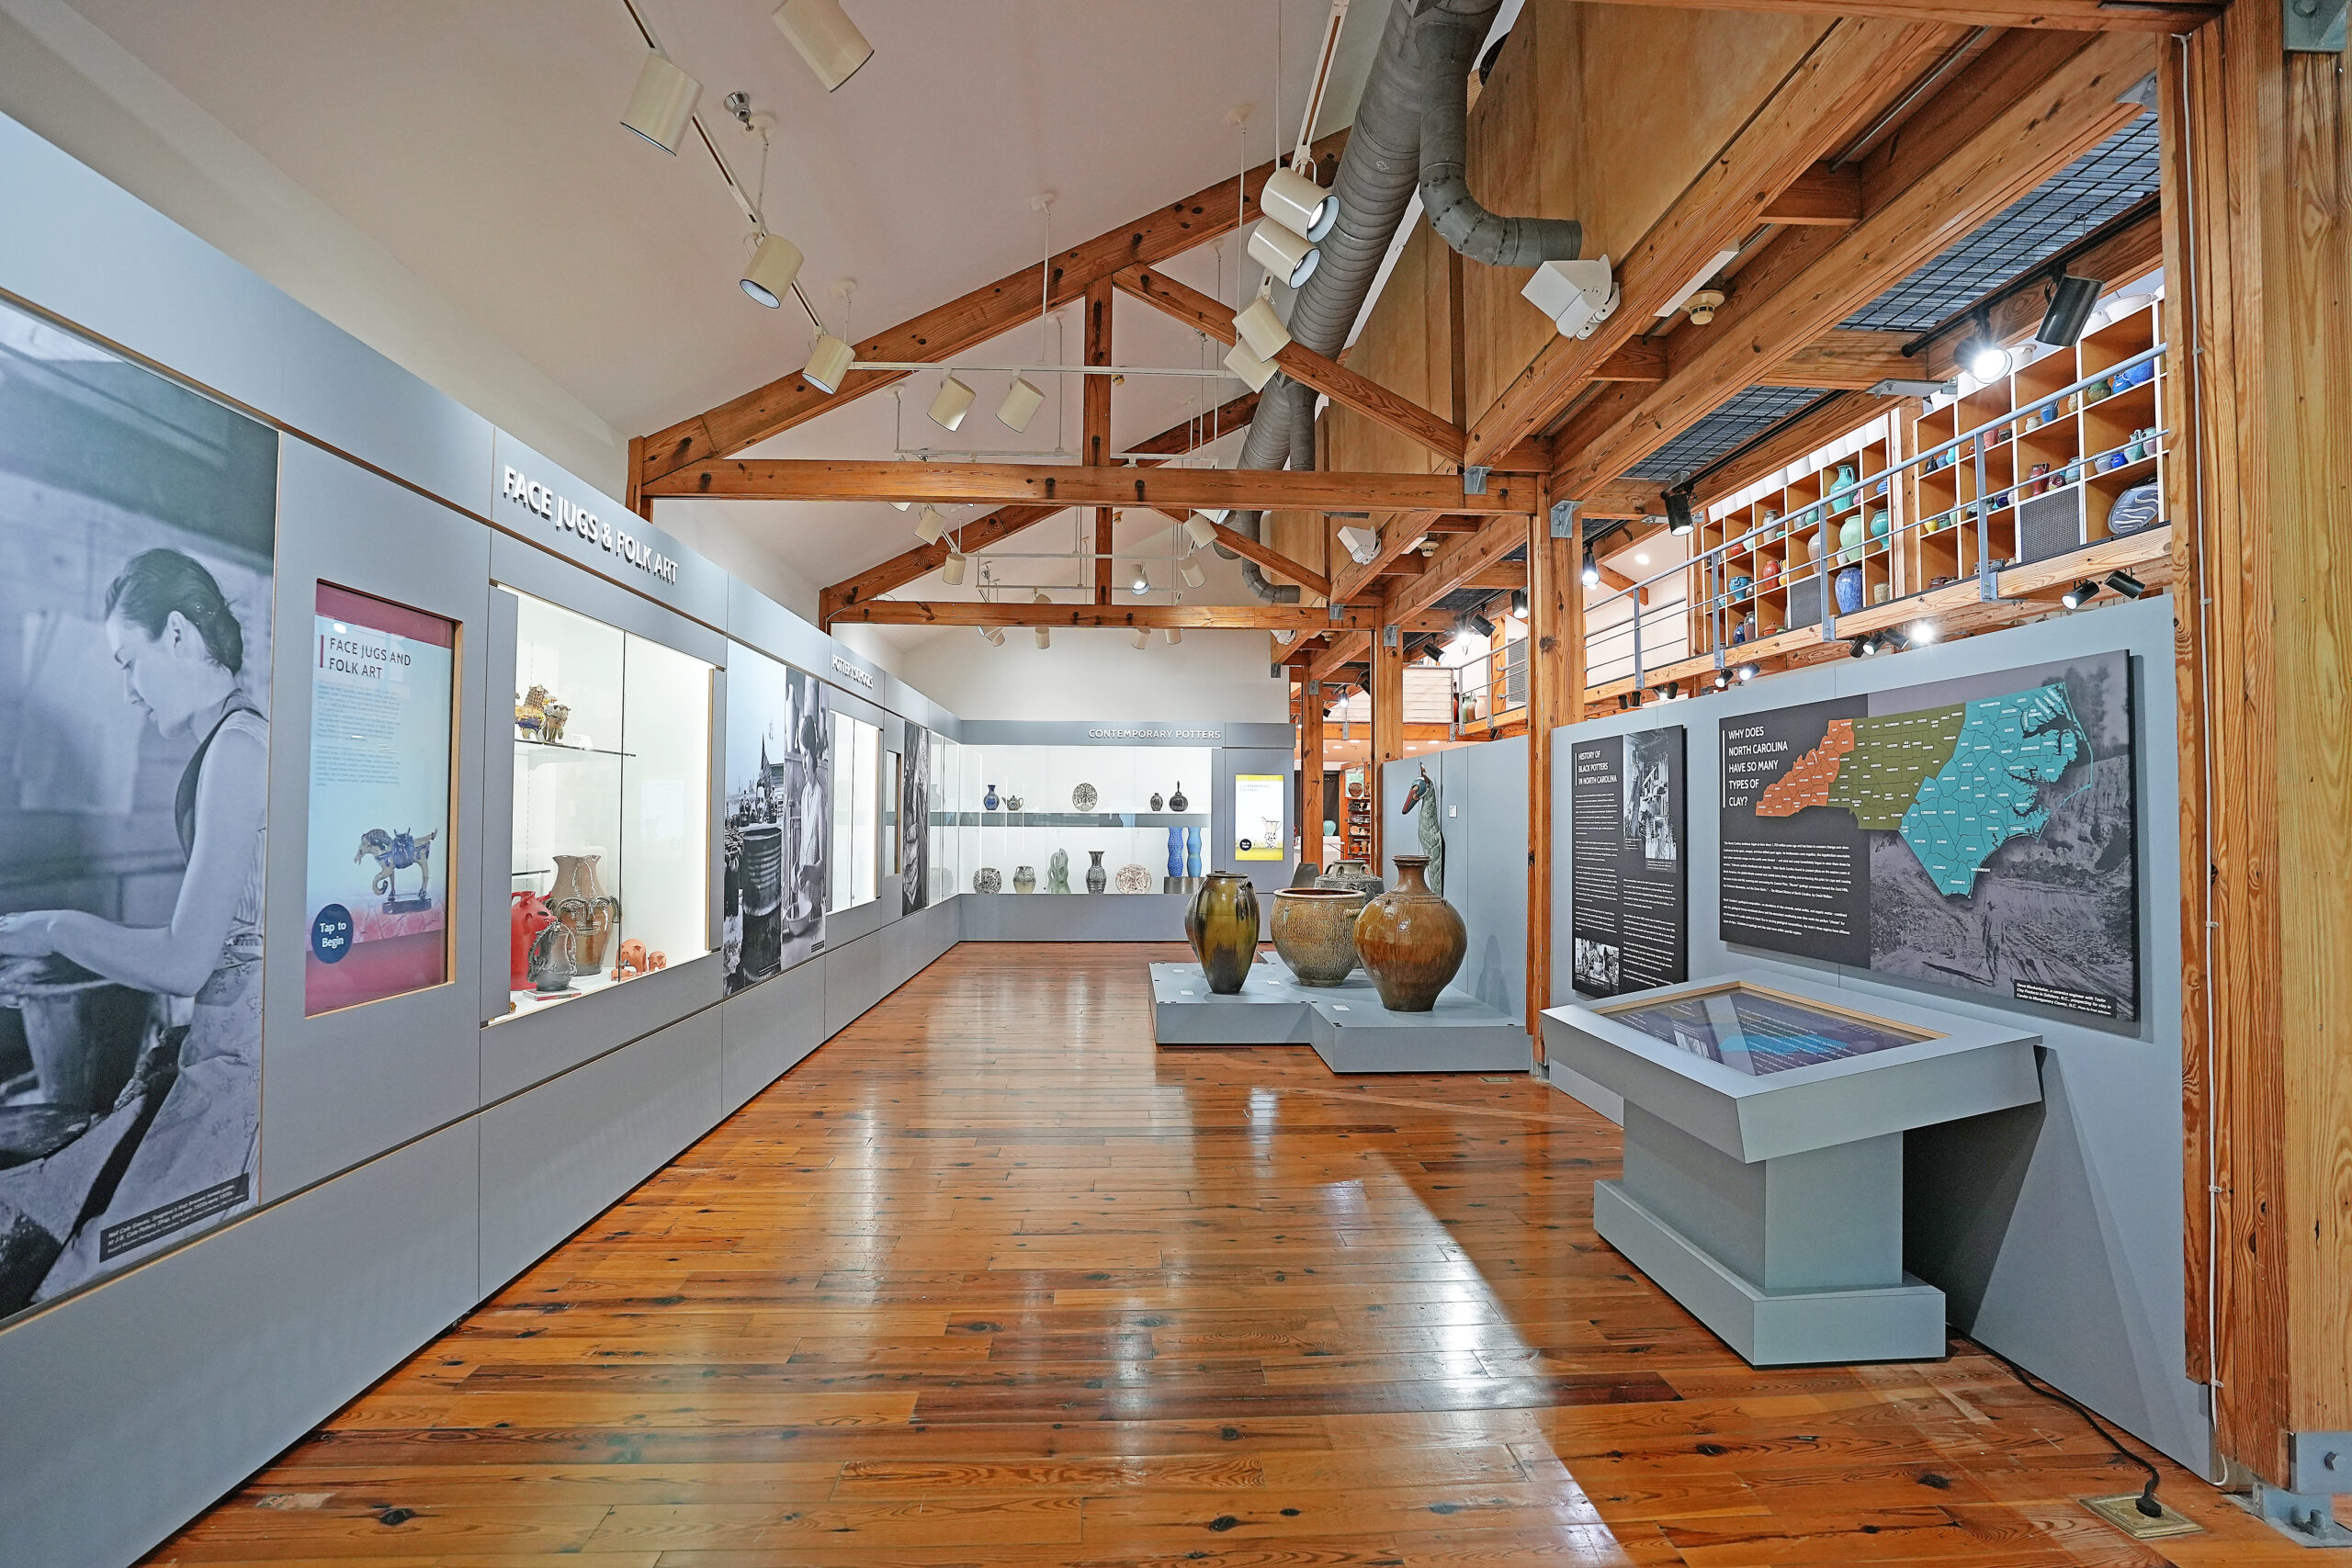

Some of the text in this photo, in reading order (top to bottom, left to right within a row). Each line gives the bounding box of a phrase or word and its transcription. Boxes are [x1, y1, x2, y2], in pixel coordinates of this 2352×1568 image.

[503, 465, 678, 582] FACE JUGS & FOLK ART
[330, 637, 411, 666] FACE JUGS AND
[329, 657, 382, 679] FOLK ART
[1089, 728, 1221, 739] CONTEMPORARY POTTERS
[1728, 726, 1764, 740] WHY DOES
[1728, 740, 1788, 757] NORTH CAROLINA
[1577, 750, 1601, 761] HISTORY OF
[1577, 762, 1609, 773] BLACK POTTERS
[1728, 760, 1779, 773] HAVE SO MANY
[1577, 774, 1618, 785] IN NORTH CAROLINA
[1728, 778, 1760, 790] TYPES OF
[1728, 795, 1748, 807] CLAY?
[319, 921, 346, 935] Tap to
[322, 935, 345, 949] Begin
